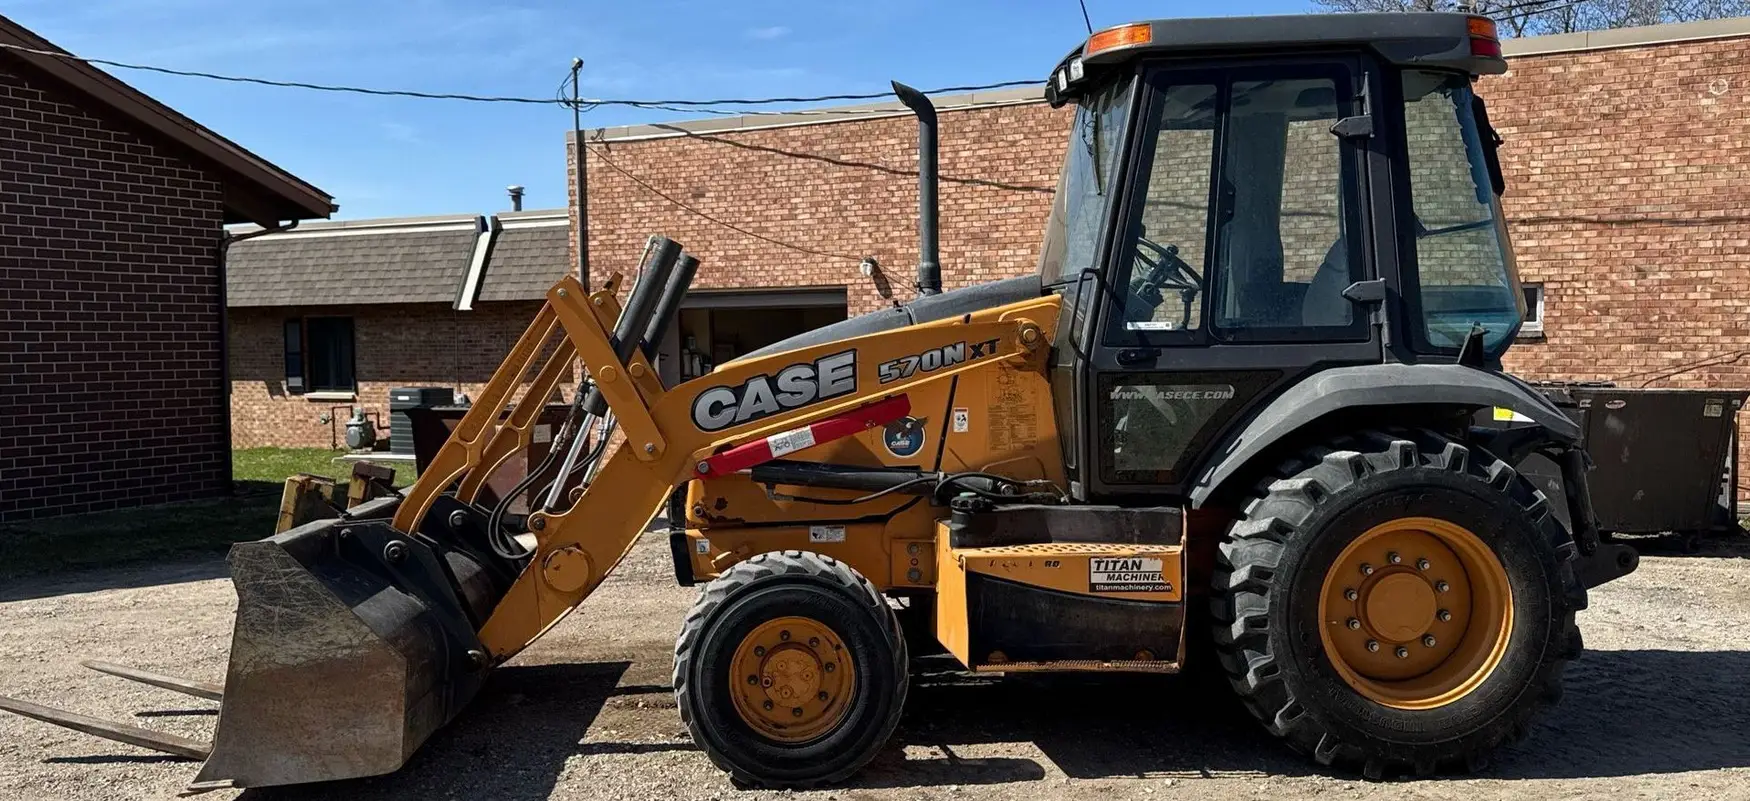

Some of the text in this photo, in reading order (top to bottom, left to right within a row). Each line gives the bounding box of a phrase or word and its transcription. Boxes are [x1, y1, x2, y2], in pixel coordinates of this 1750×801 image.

[879, 338, 1000, 384] 570N XT
[692, 350, 857, 430] CASE
[1110, 391, 1234, 399] WWW.ASECE.COM
[1094, 559, 1142, 571] TITAN
[1095, 584, 1172, 592] titanmachinery.com
